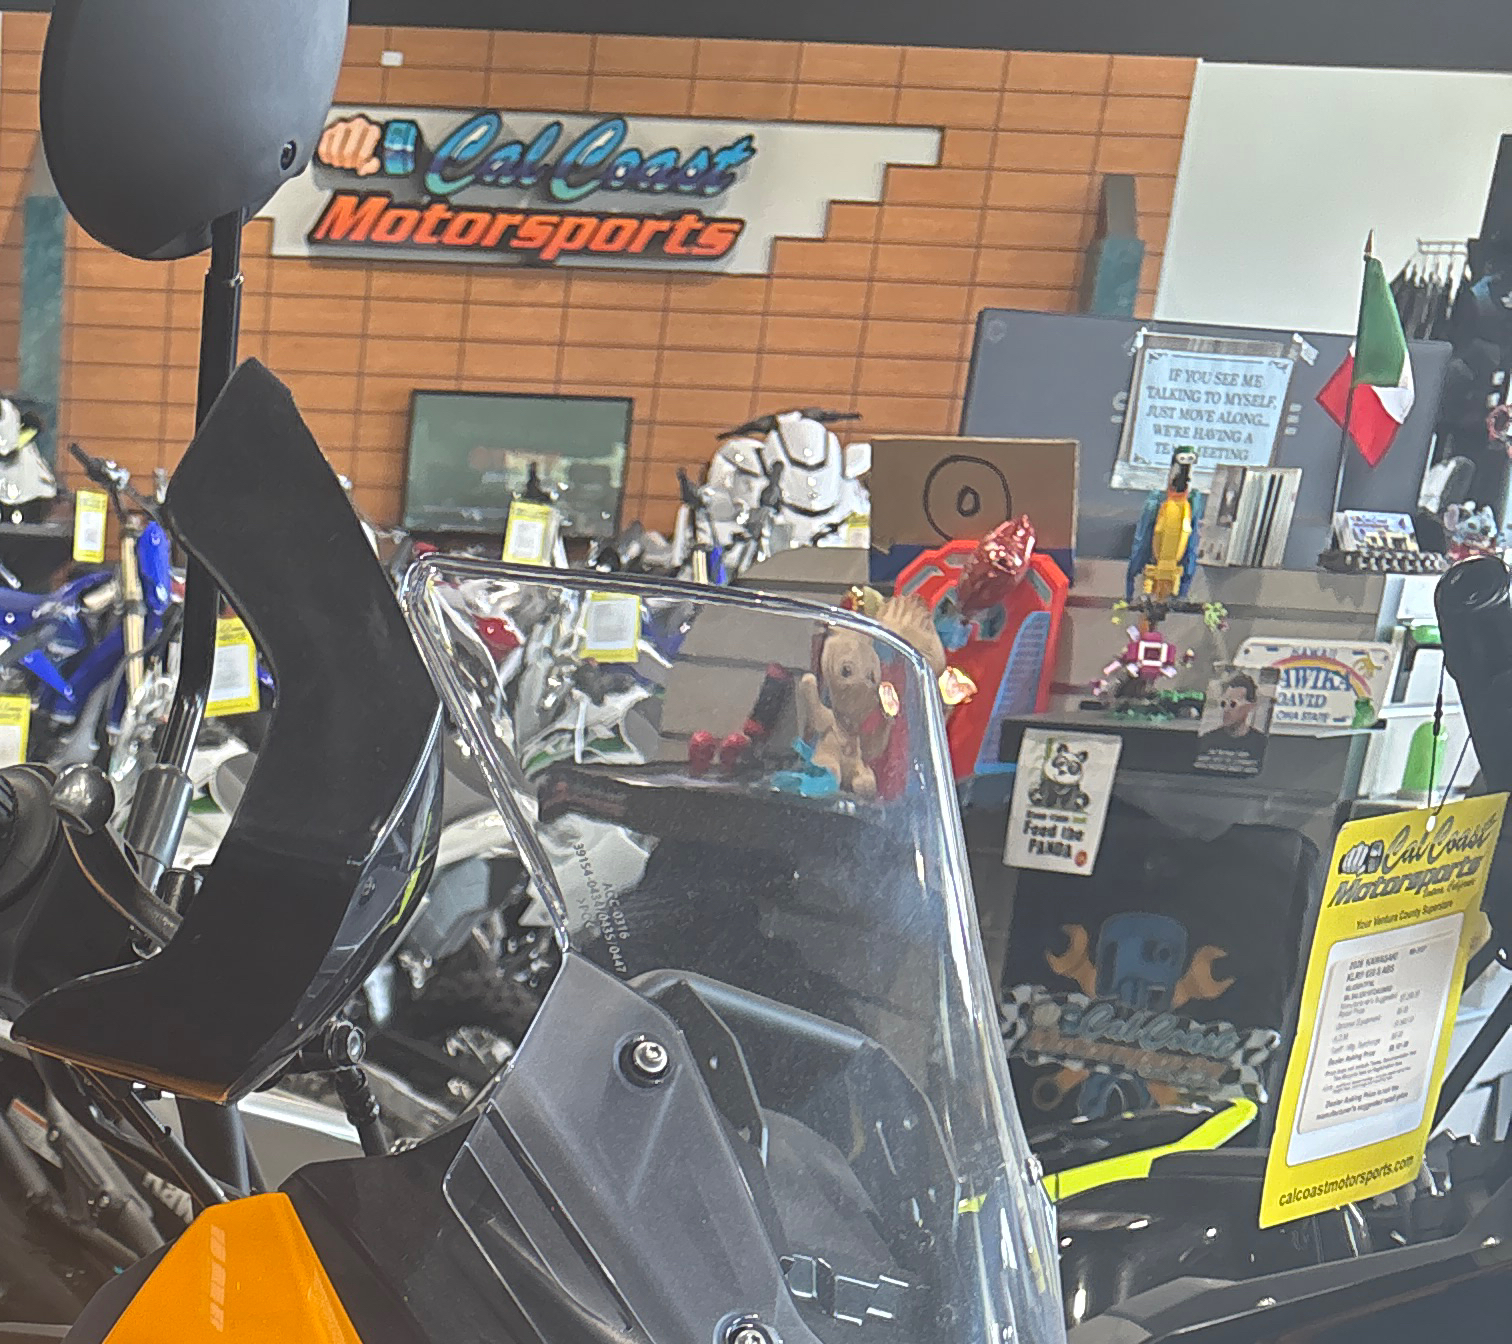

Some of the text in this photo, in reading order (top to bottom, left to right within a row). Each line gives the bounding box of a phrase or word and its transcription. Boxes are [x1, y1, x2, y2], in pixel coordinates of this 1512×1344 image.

[425, 110, 756, 202] Cal Coast
[309, 191, 745, 261] Motorsports
[1146, 386, 1201, 403] TALKING
[1204, 390, 1221, 405] TO
[1169, 368, 1264, 388] IF YOU SEE ME
[1146, 405, 1176, 419] JUST
[1179, 407, 1216, 422] MOVE
[1192, 425, 1242, 443] HAVING
[1244, 431, 1254, 444] A
[1023, 820, 1057, 839] Feed
[1382, 813, 1497, 874] Cal Coast
[1327, 855, 1484, 908] Motorsports
[1279, 1154, 1414, 1207] calcoastmotorsports.com
